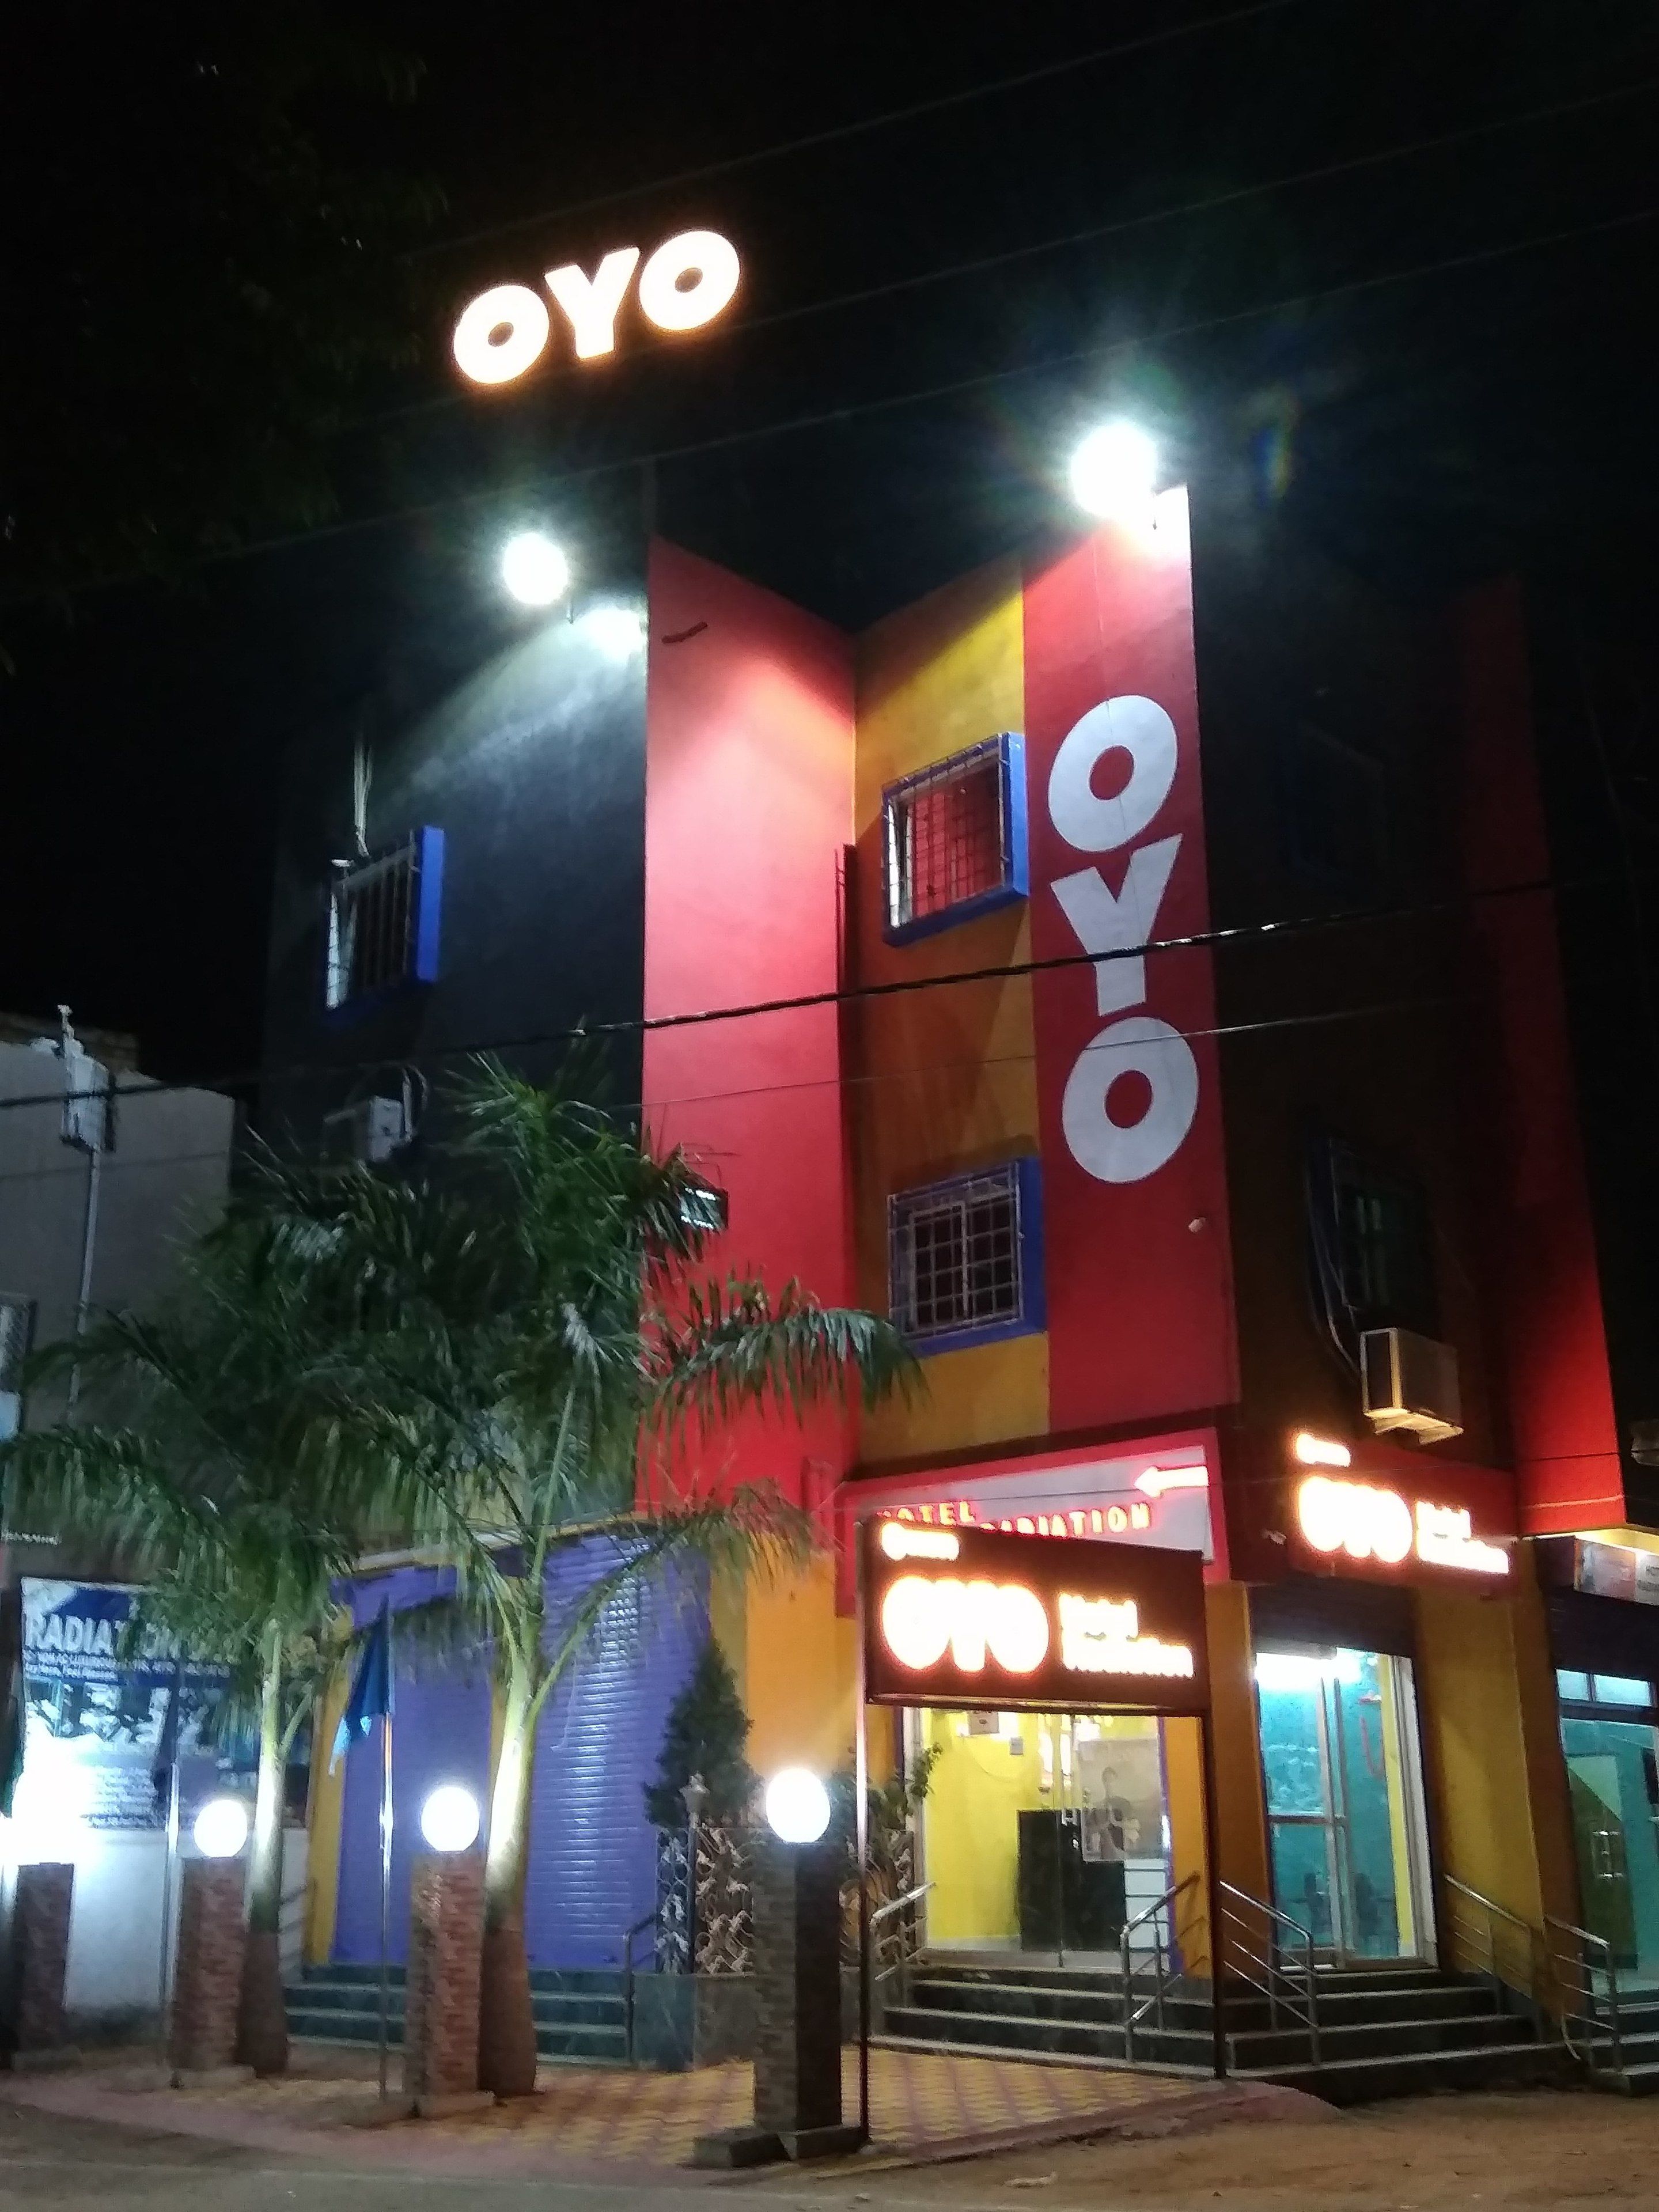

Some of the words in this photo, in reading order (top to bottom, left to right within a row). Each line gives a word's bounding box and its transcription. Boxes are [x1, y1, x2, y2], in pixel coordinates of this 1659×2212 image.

[453, 230, 741, 384] OYO
[1048, 694, 1199, 1184] OYO
[876, 1501, 977, 1527] OTEL
